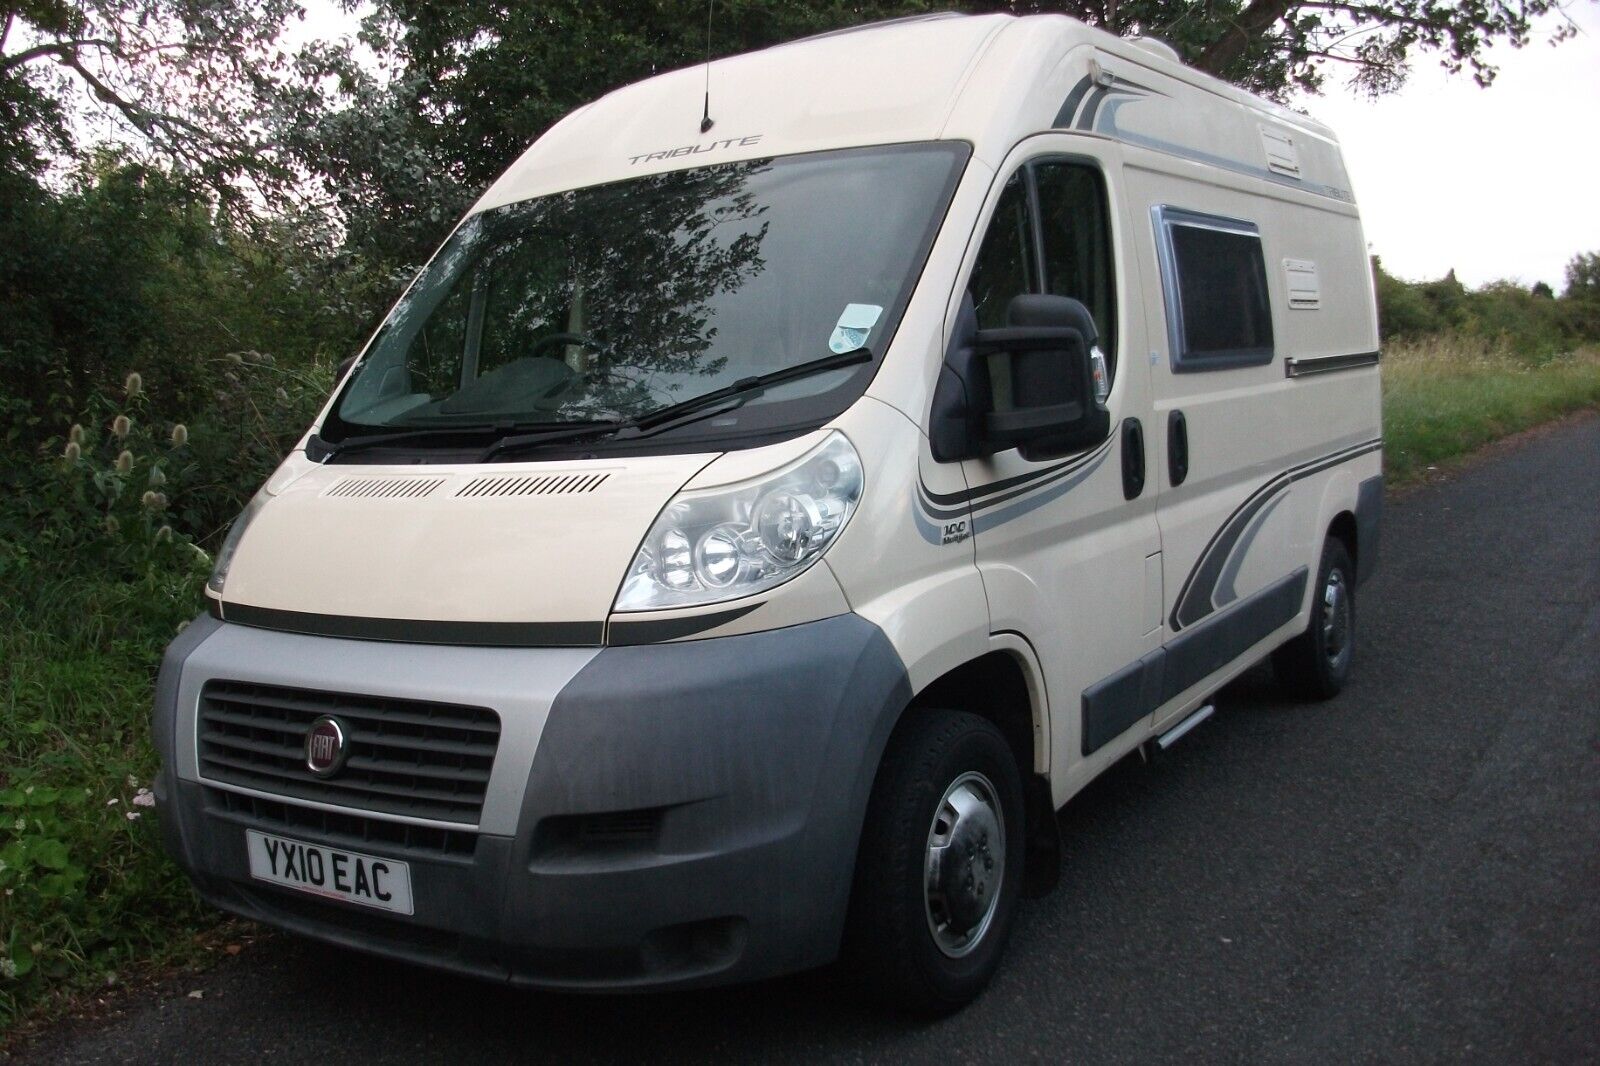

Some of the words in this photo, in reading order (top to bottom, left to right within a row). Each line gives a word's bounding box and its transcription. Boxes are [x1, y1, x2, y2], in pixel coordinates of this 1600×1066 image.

[628, 134, 763, 165] TRIBUTE
[943, 521, 965, 536] 100
[312, 734, 336, 761] FIAT
[264, 837, 325, 886] YX10
[331, 852, 392, 902] EAC
